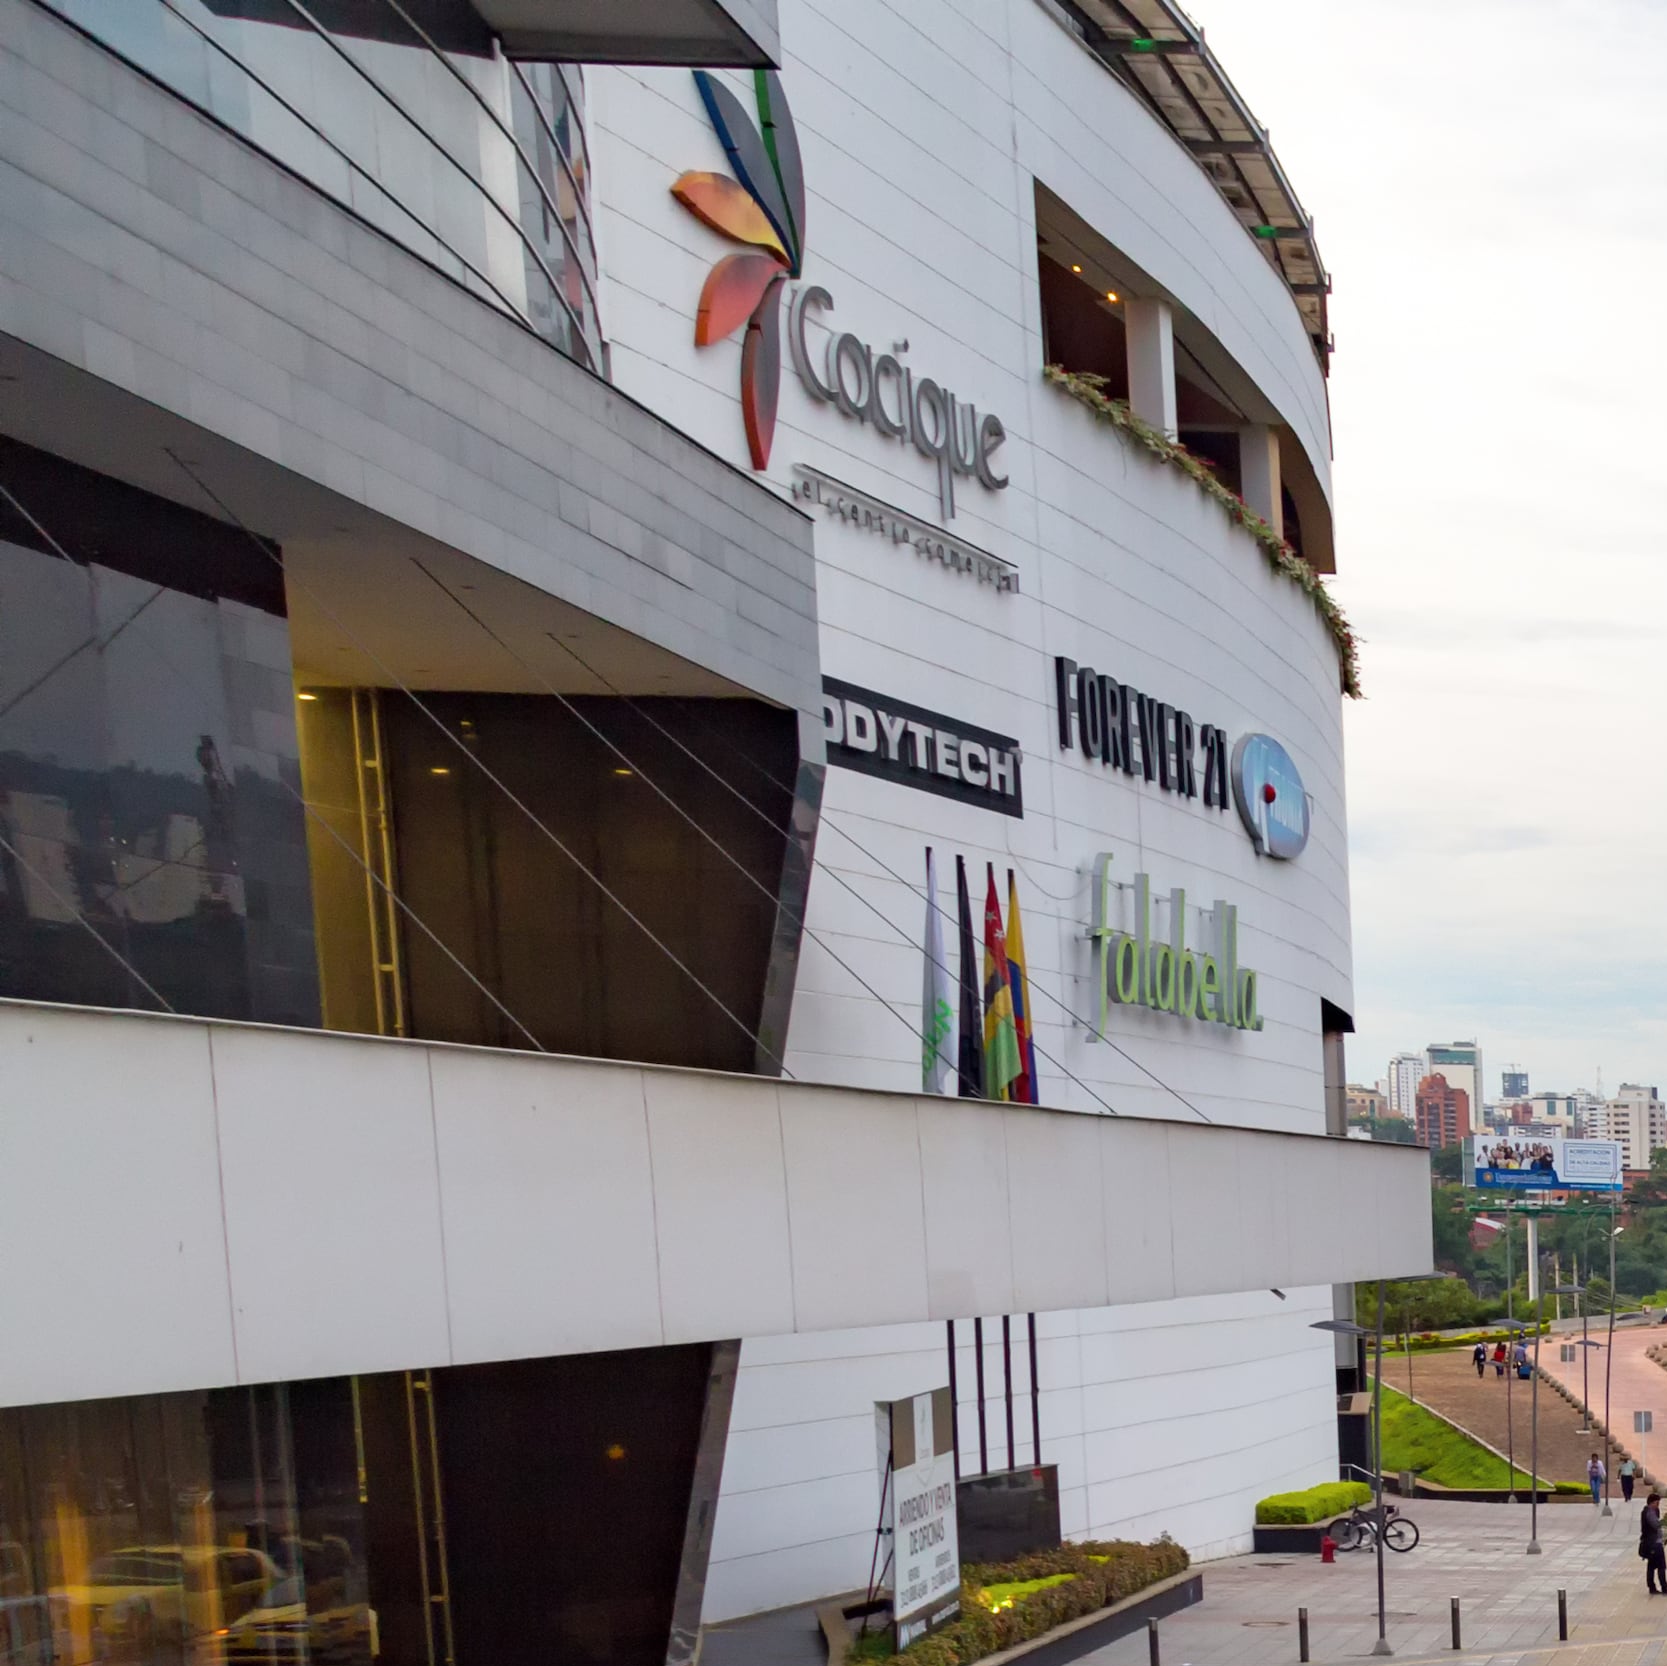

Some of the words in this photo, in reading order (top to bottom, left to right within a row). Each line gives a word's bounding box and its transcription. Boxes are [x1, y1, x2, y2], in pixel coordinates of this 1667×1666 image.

[789, 286, 1009, 520] Cacique
[822, 694, 1016, 796] ODYTECH
[1055, 656, 1198, 798] FOREVER
[1202, 722, 1230, 811] 21
